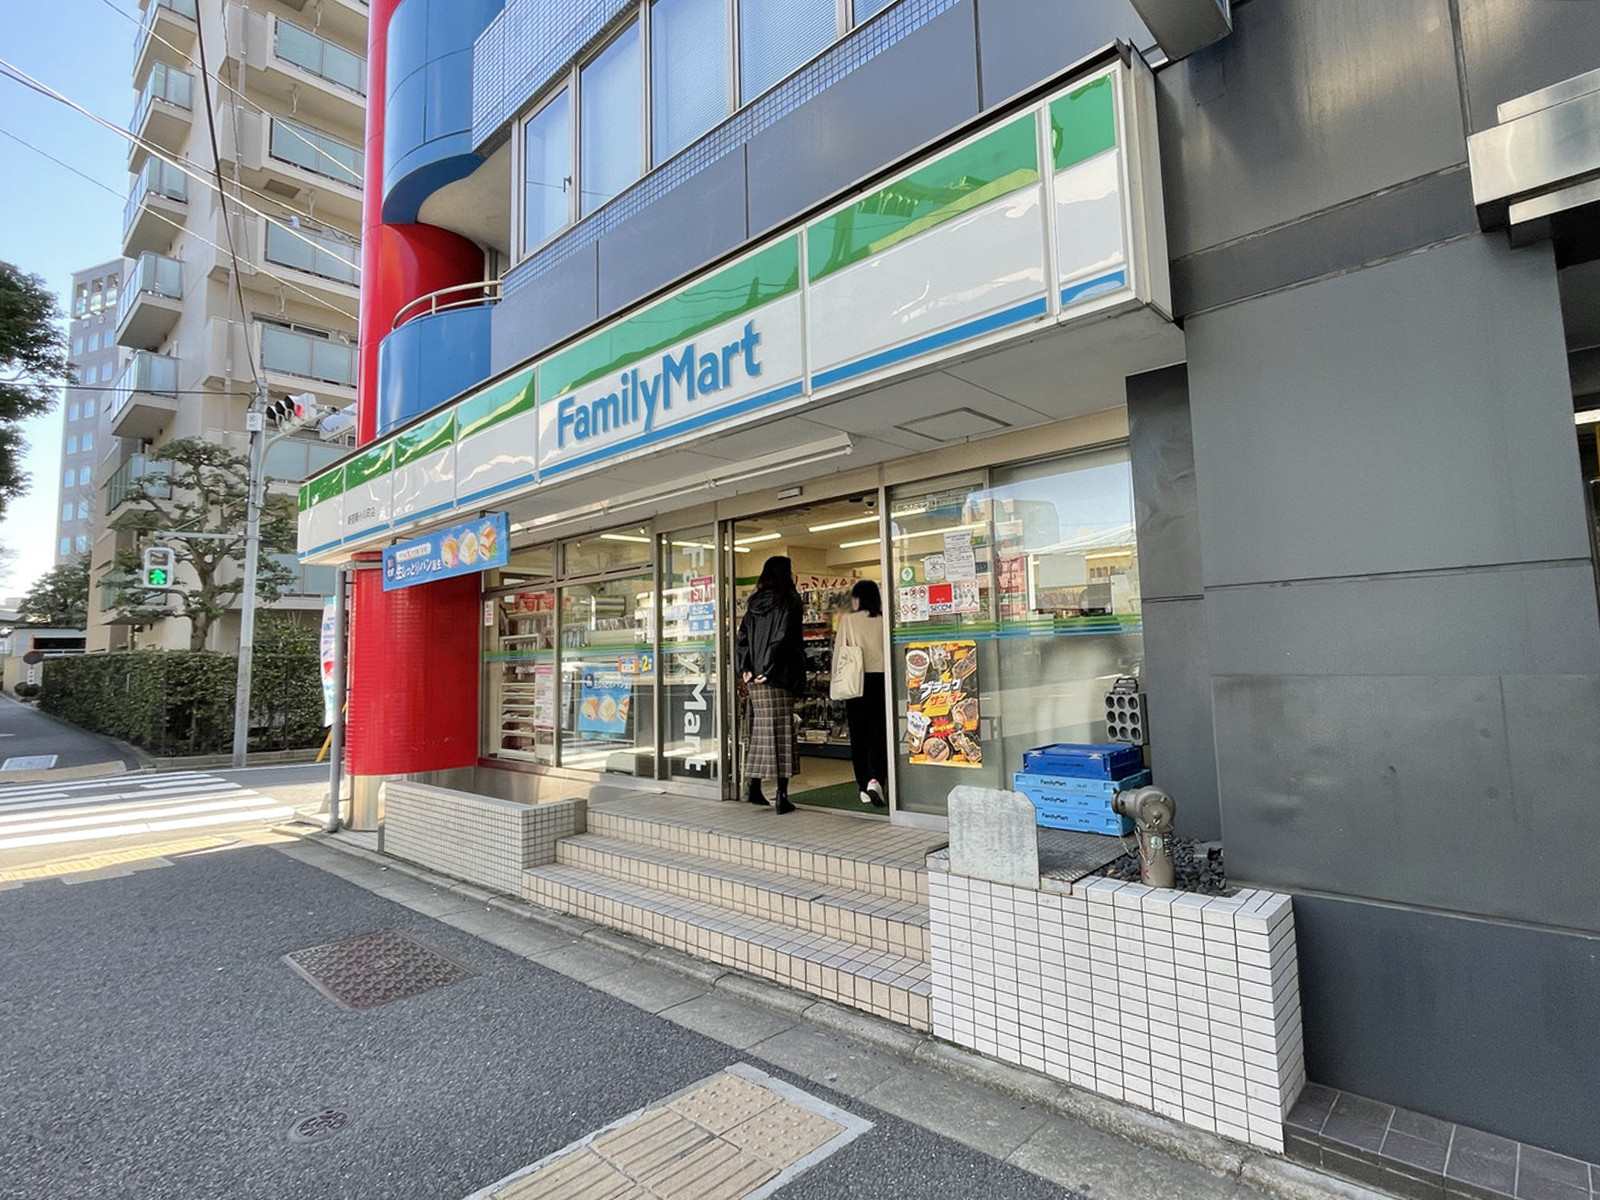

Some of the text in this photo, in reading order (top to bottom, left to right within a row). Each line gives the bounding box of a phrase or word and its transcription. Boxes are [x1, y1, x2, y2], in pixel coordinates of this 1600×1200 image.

[557, 319, 763, 448] FamilyMart
[920, 678, 961, 700] ブラック
[1040, 779, 1067, 787] FamilyMart
[1041, 795, 1068, 803] FamilyMart
[1042, 812, 1069, 821] FamilyMart
